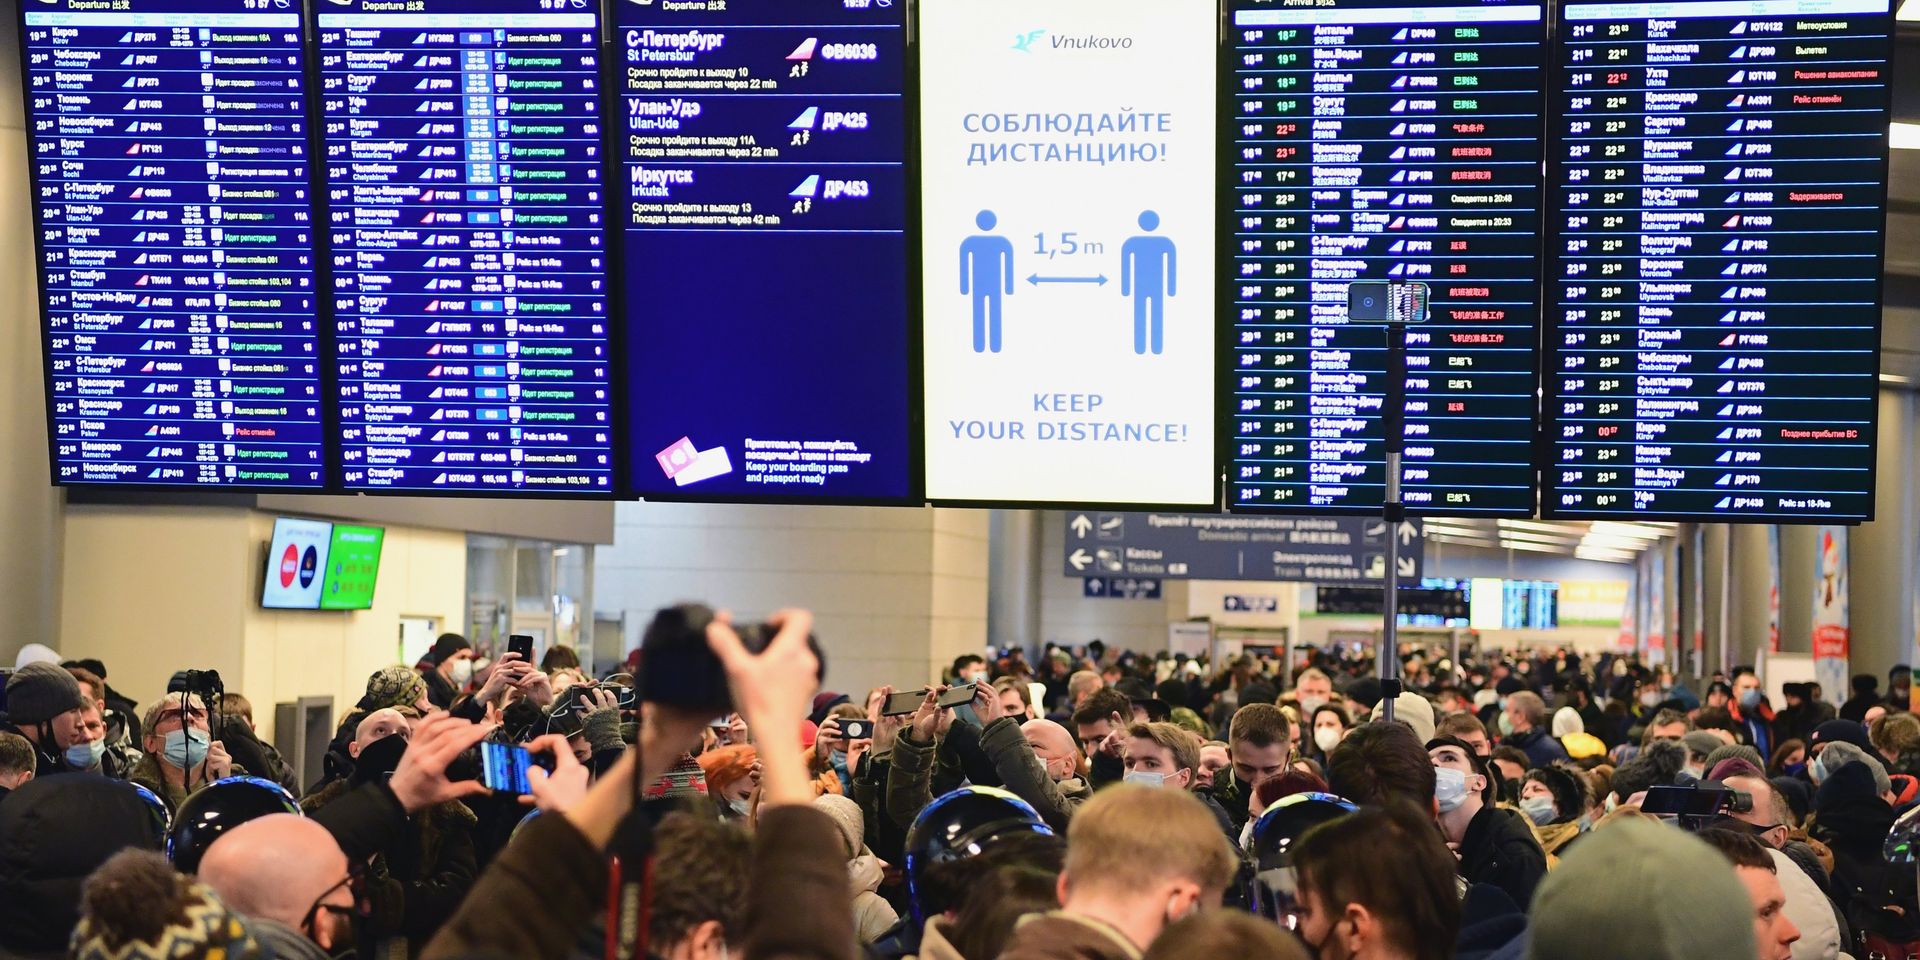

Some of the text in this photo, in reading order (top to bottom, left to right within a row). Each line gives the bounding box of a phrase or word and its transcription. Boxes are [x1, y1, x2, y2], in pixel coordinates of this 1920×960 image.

[68, 0, 110, 10] Departure
[362, 1, 404, 11] Departure
[407, 1, 424, 11] 出发
[663, 1, 705, 11] Departure
[708, 0, 726, 10] 出发
[1648, 19, 1676, 32] Курск
[52, 27, 78, 37] Киров
[1648, 29, 1668, 37] Kursk
[627, 30, 724, 50] С-Петербург
[1052, 35, 1132, 48] Vnukovo
[1647, 43, 1699, 55] Махачкала
[1796, 46, 1827, 54] Вылетел
[54, 49, 100, 61] Чебоксары
[628, 49, 695, 61] St Petersbur
[1647, 54, 1690, 62] Makhachkala
[55, 60, 89, 68] Cheboksary
[628, 68, 658, 78] Срочно
[660, 68, 698, 78] пройдите
[706, 69, 736, 78] выходу
[1646, 68, 1668, 80] Ухта
[1795, 71, 1827, 79] Решение
[628, 79, 662, 89] Посадка
[725, 81, 748, 90] через
[750, 79, 760, 88] 22
[762, 80, 777, 88] min
[57, 94, 90, 105] Тюмень
[1645, 92, 1698, 105] Краснодар
[58, 104, 81, 112] Tyumen
[629, 99, 700, 117] Улан-Удэ
[1645, 101, 1681, 110] Krasnodar
[630, 117, 679, 129] Ulan-Ude
[822, 112, 867, 130] ДР425
[964, 108, 1170, 136] СОБЛЮДАЙТЕ
[1645, 116, 1685, 128] Саратов
[1645, 126, 1670, 134] Saratov
[61, 139, 85, 150] Курск
[630, 135, 660, 146] Срочно
[662, 135, 700, 146] пройдите
[708, 137, 738, 146] выходу
[1644, 140, 1692, 152] Мурманск
[631, 147, 664, 157] Посадка
[726, 149, 750, 158] через
[752, 147, 762, 157] 22
[764, 147, 778, 156] min
[968, 143, 1165, 165] ДИСТАНЦИЮ!
[1644, 150, 1678, 158] Murmansk
[62, 161, 83, 170] Сочи
[632, 166, 693, 186] Иркутск
[1643, 173, 1683, 182] Vladikavkaz
[64, 183, 115, 194] С-Петербург
[632, 185, 669, 196] Irkutsk
[824, 181, 868, 198] ДР453
[1642, 188, 1698, 199] Нур-Султан
[1642, 198, 1678, 206] Nur-Sultan
[1790, 193, 1843, 201] Задерживается
[65, 205, 103, 216] Улан-Удэ
[632, 203, 662, 215] Срочно
[664, 203, 702, 213] пройдите
[710, 205, 739, 214] выходу
[633, 214, 780, 225] Посадка заканчивается через 42 min
[67, 226, 100, 238] Иркутск
[1640, 233, 1692, 247] Волгоград
[1034, 233, 1077, 259] 1,5
[69, 248, 116, 259] Красноярск
[70, 270, 106, 281] Стамбул
[1640, 269, 1672, 277] Voronezh
[75, 335, 96, 344] Омск
[1638, 339, 1662, 349] Grozny
[79, 399, 122, 411] Краснодар
[1034, 394, 1102, 411] KEEP
[80, 420, 105, 431] Псков
[950, 421, 1186, 441] YOUR DISTANCE!
[1636, 422, 1666, 434] Киров
[1636, 432, 1654, 440] Kirov
[82, 442, 121, 453] Кемерово
[746, 462, 848, 473] Keep your boarding pass
[746, 473, 825, 485] and passport ready
